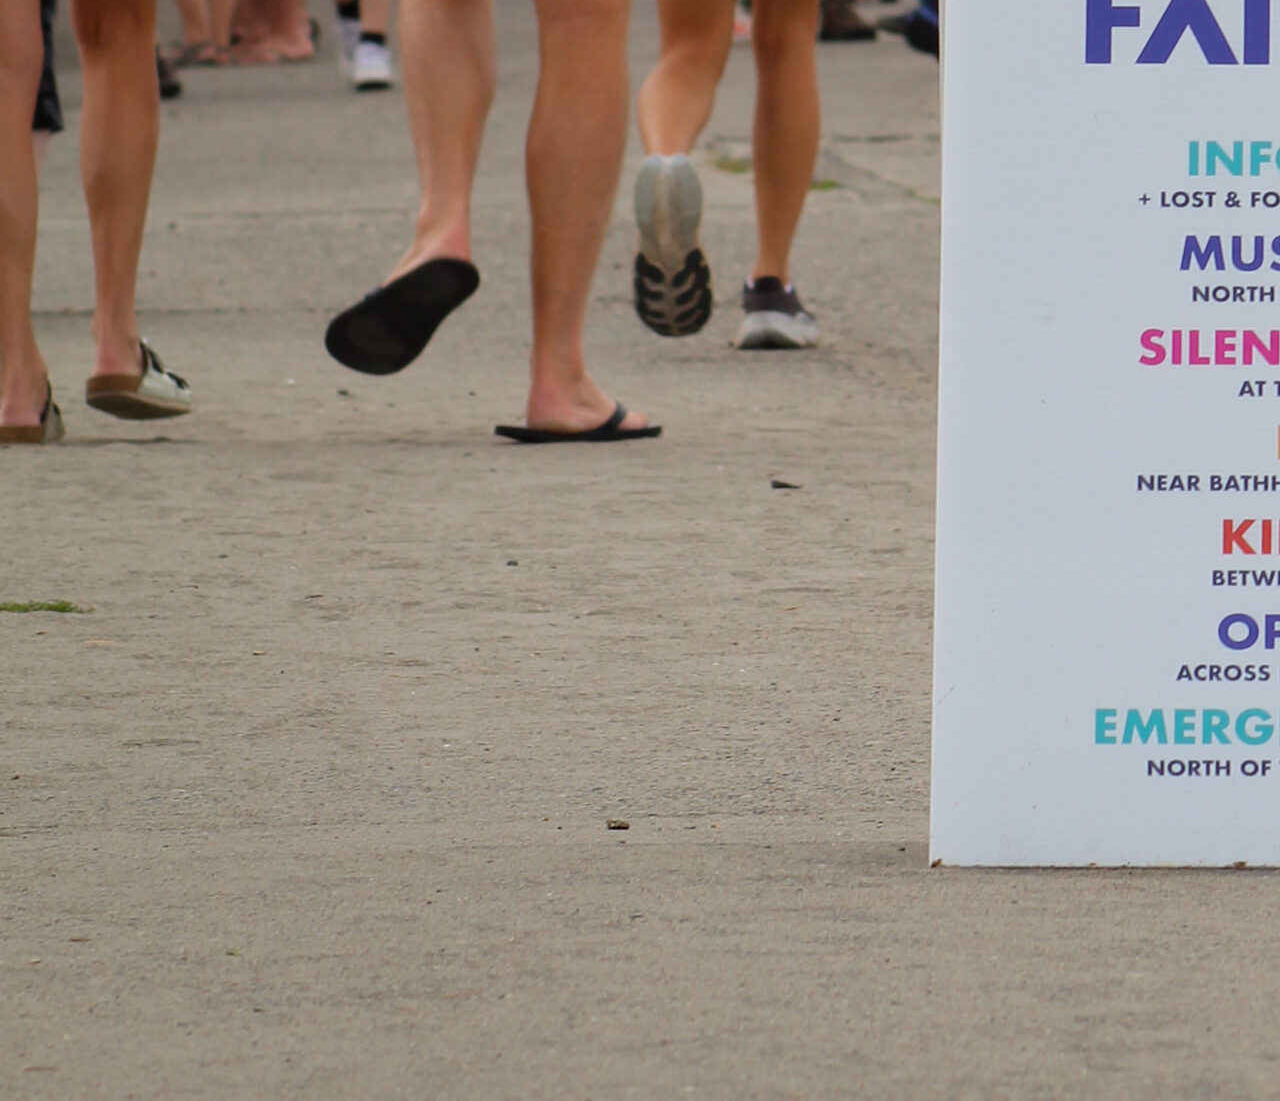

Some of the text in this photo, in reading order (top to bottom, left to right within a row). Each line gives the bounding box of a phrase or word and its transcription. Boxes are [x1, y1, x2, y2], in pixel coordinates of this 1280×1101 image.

[1138, 193, 1151, 206] +
[1160, 190, 1217, 208] LOST
[1224, 190, 1241, 209] &
[1192, 285, 1275, 303] NORTH
[1238, 380, 1267, 397] AT
[1137, 474, 1201, 492] NEAR
[1176, 664, 1271, 682] ACROSS
[1147, 759, 1231, 777] NORTH
[1240, 759, 1272, 777] OF
